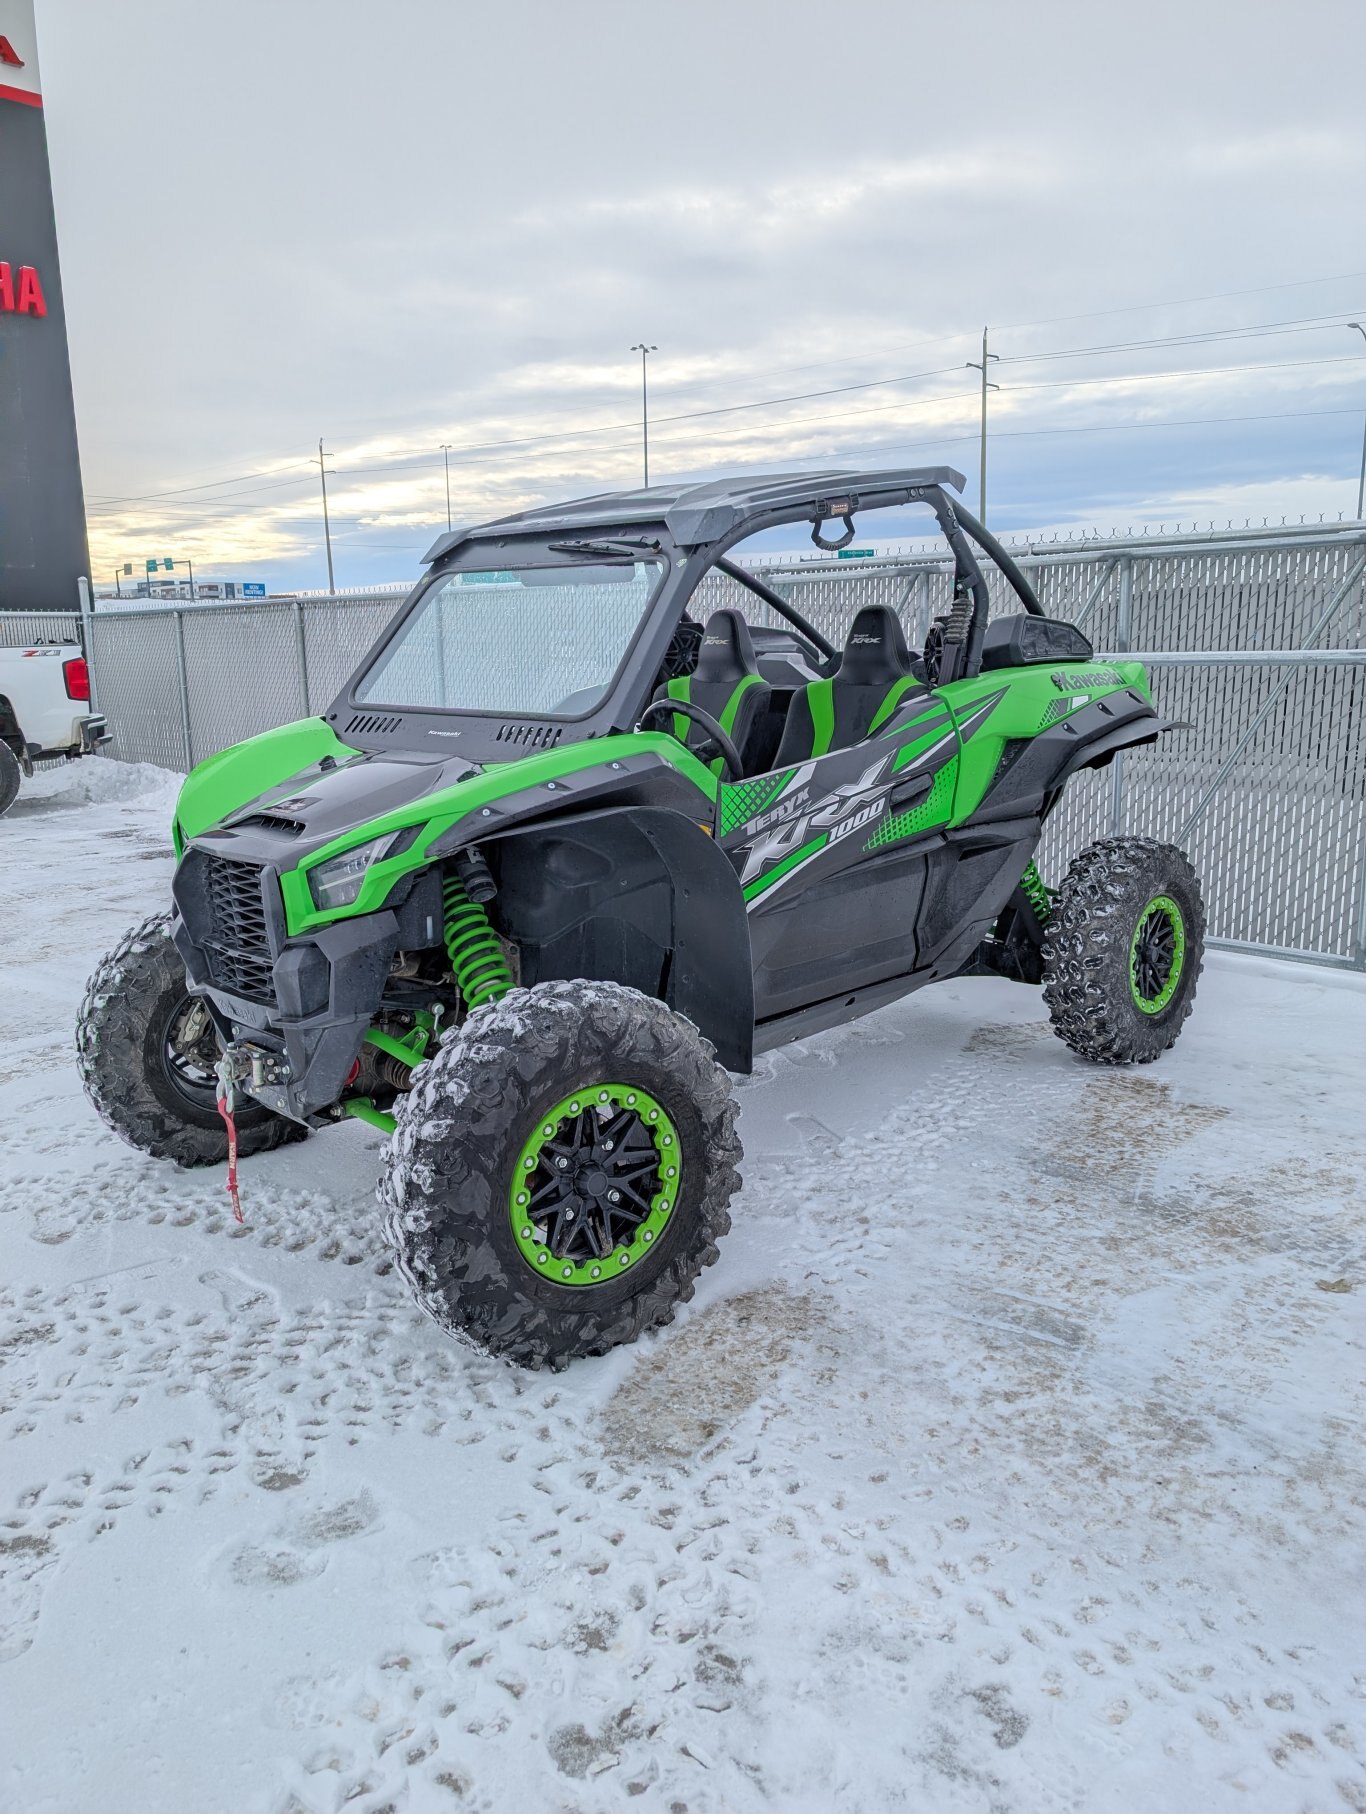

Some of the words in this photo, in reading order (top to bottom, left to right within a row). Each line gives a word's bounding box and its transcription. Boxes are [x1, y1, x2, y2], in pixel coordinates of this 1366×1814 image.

[1060, 669, 1126, 691] Kawasaki
[736, 750, 900, 884] KRX
[741, 786, 810, 836] TERYX
[829, 797, 886, 842] 1000
